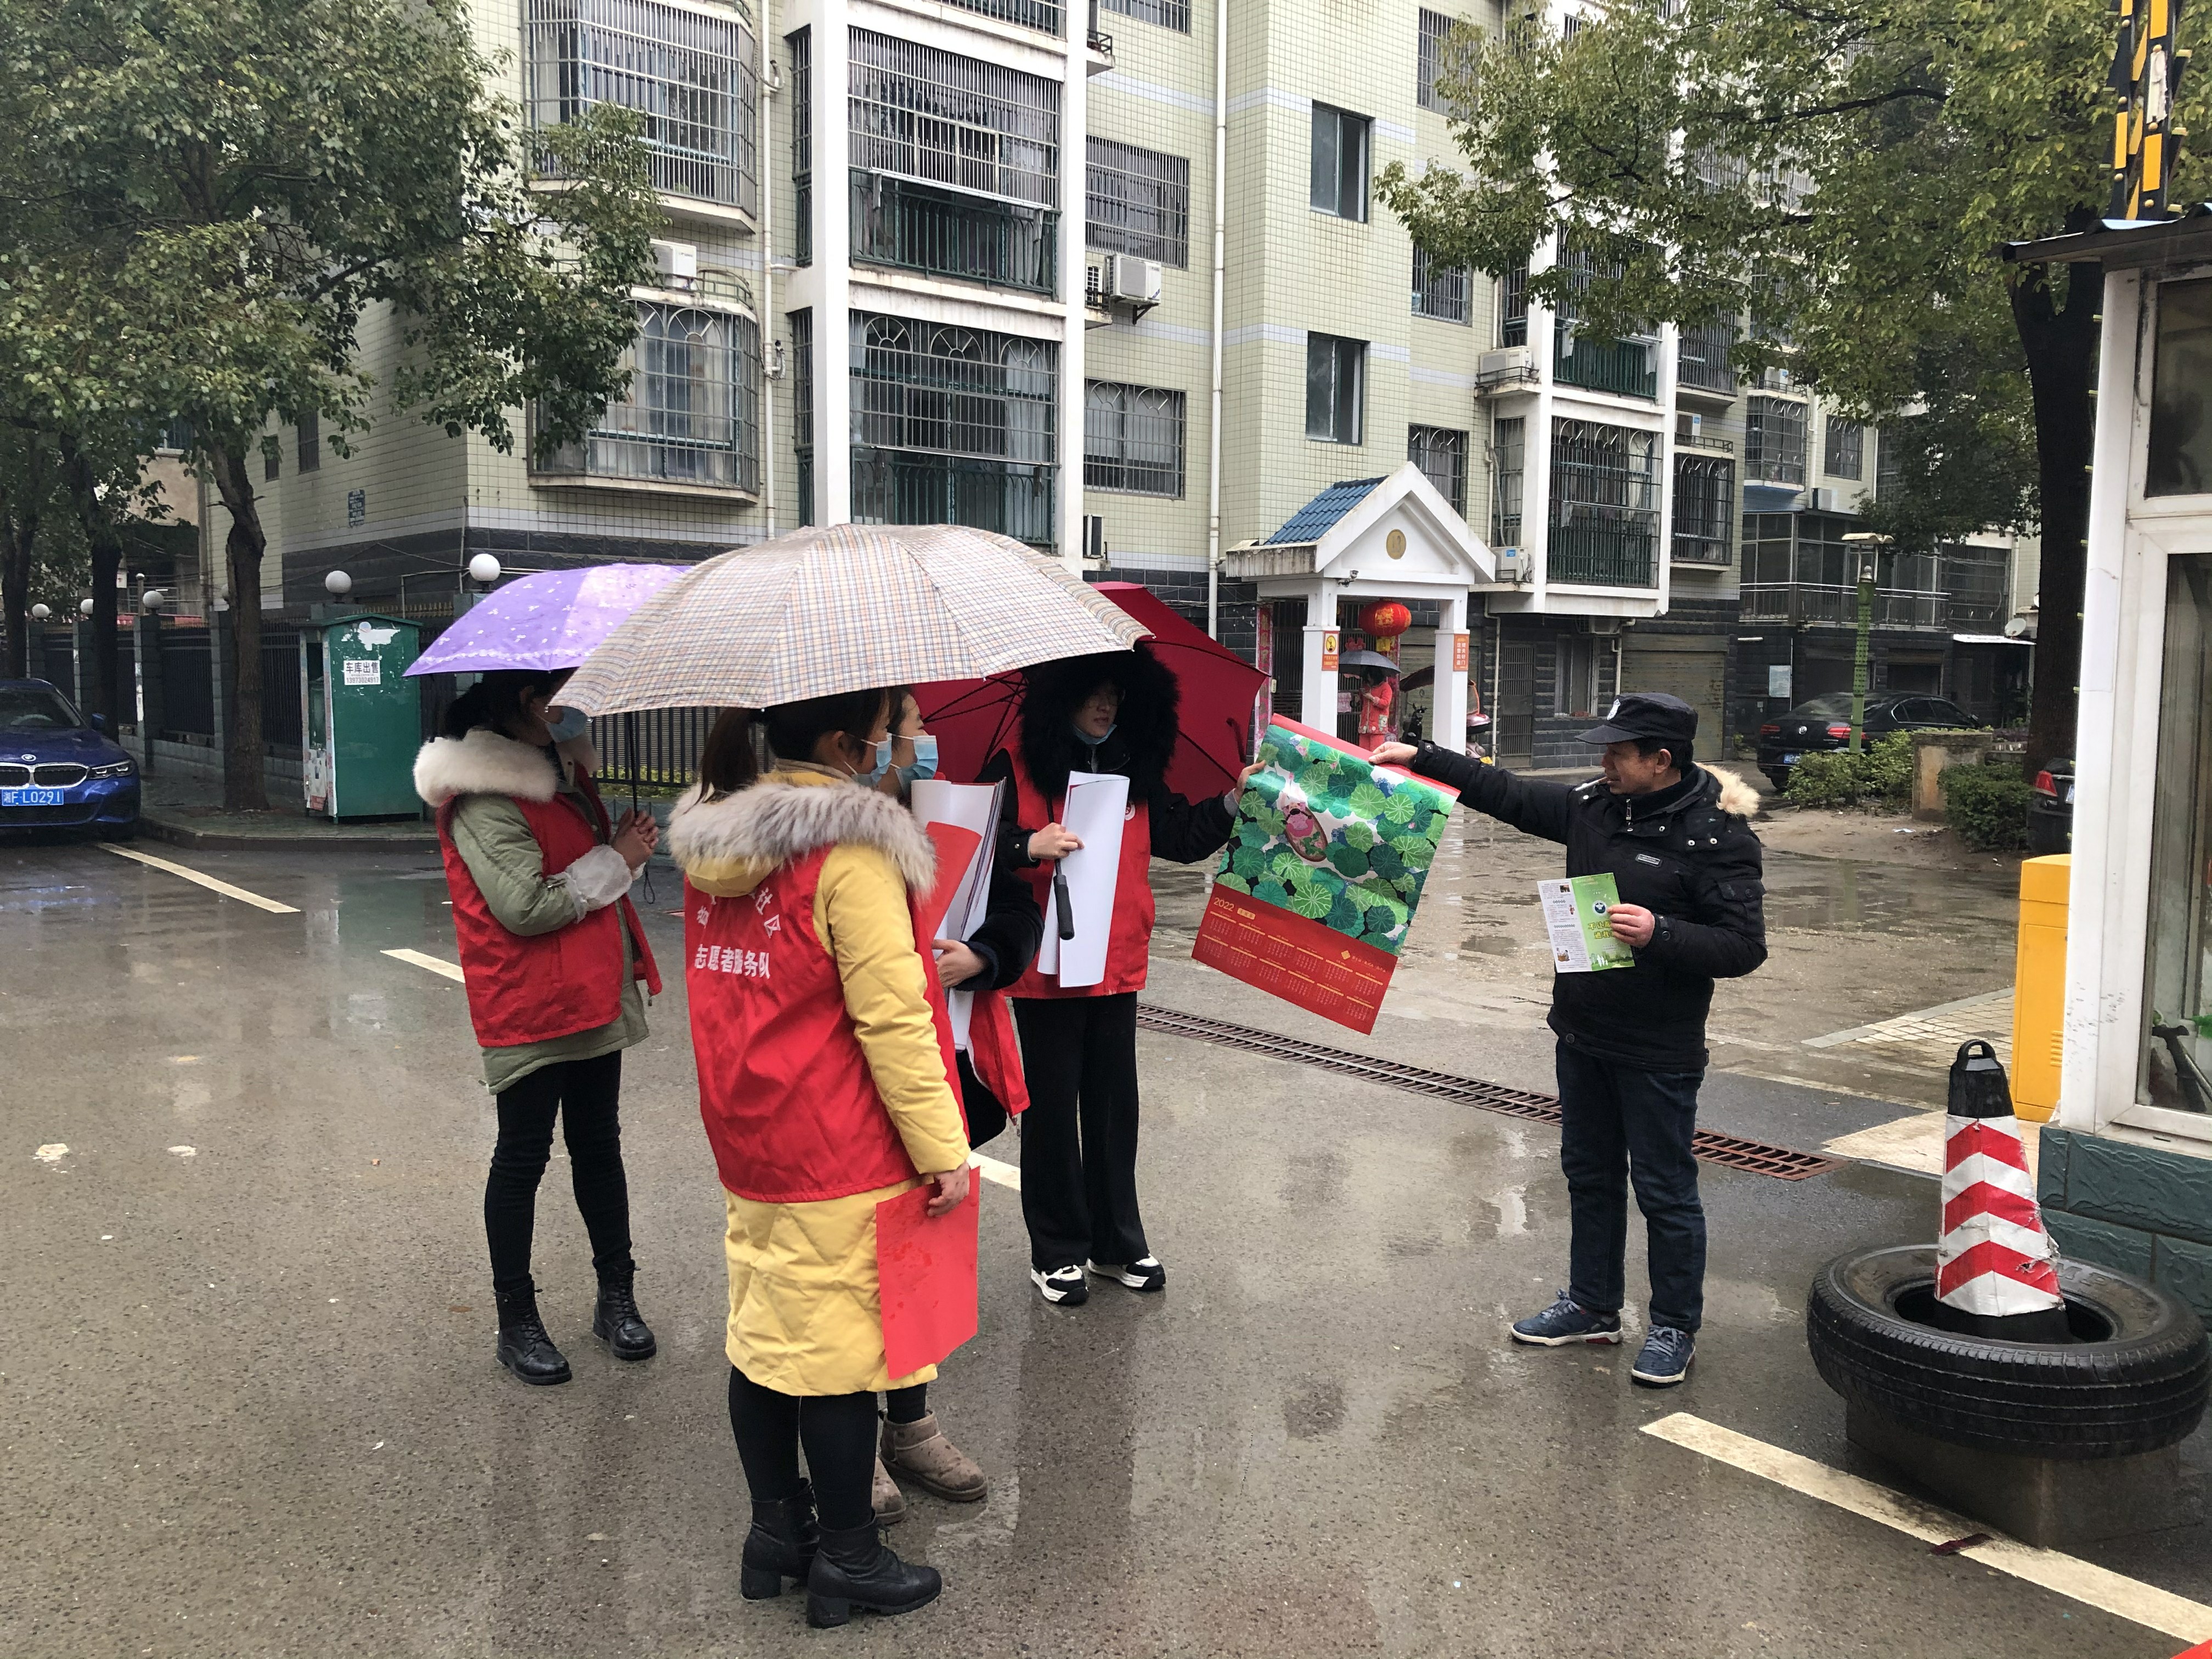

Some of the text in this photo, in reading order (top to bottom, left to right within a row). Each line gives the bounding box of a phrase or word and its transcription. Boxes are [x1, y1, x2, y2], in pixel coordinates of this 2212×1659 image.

[346, 662, 379, 674] 车库出售
[1213, 896, 1235, 912] 2022
[694, 943, 771, 979] 志愿者服务队
